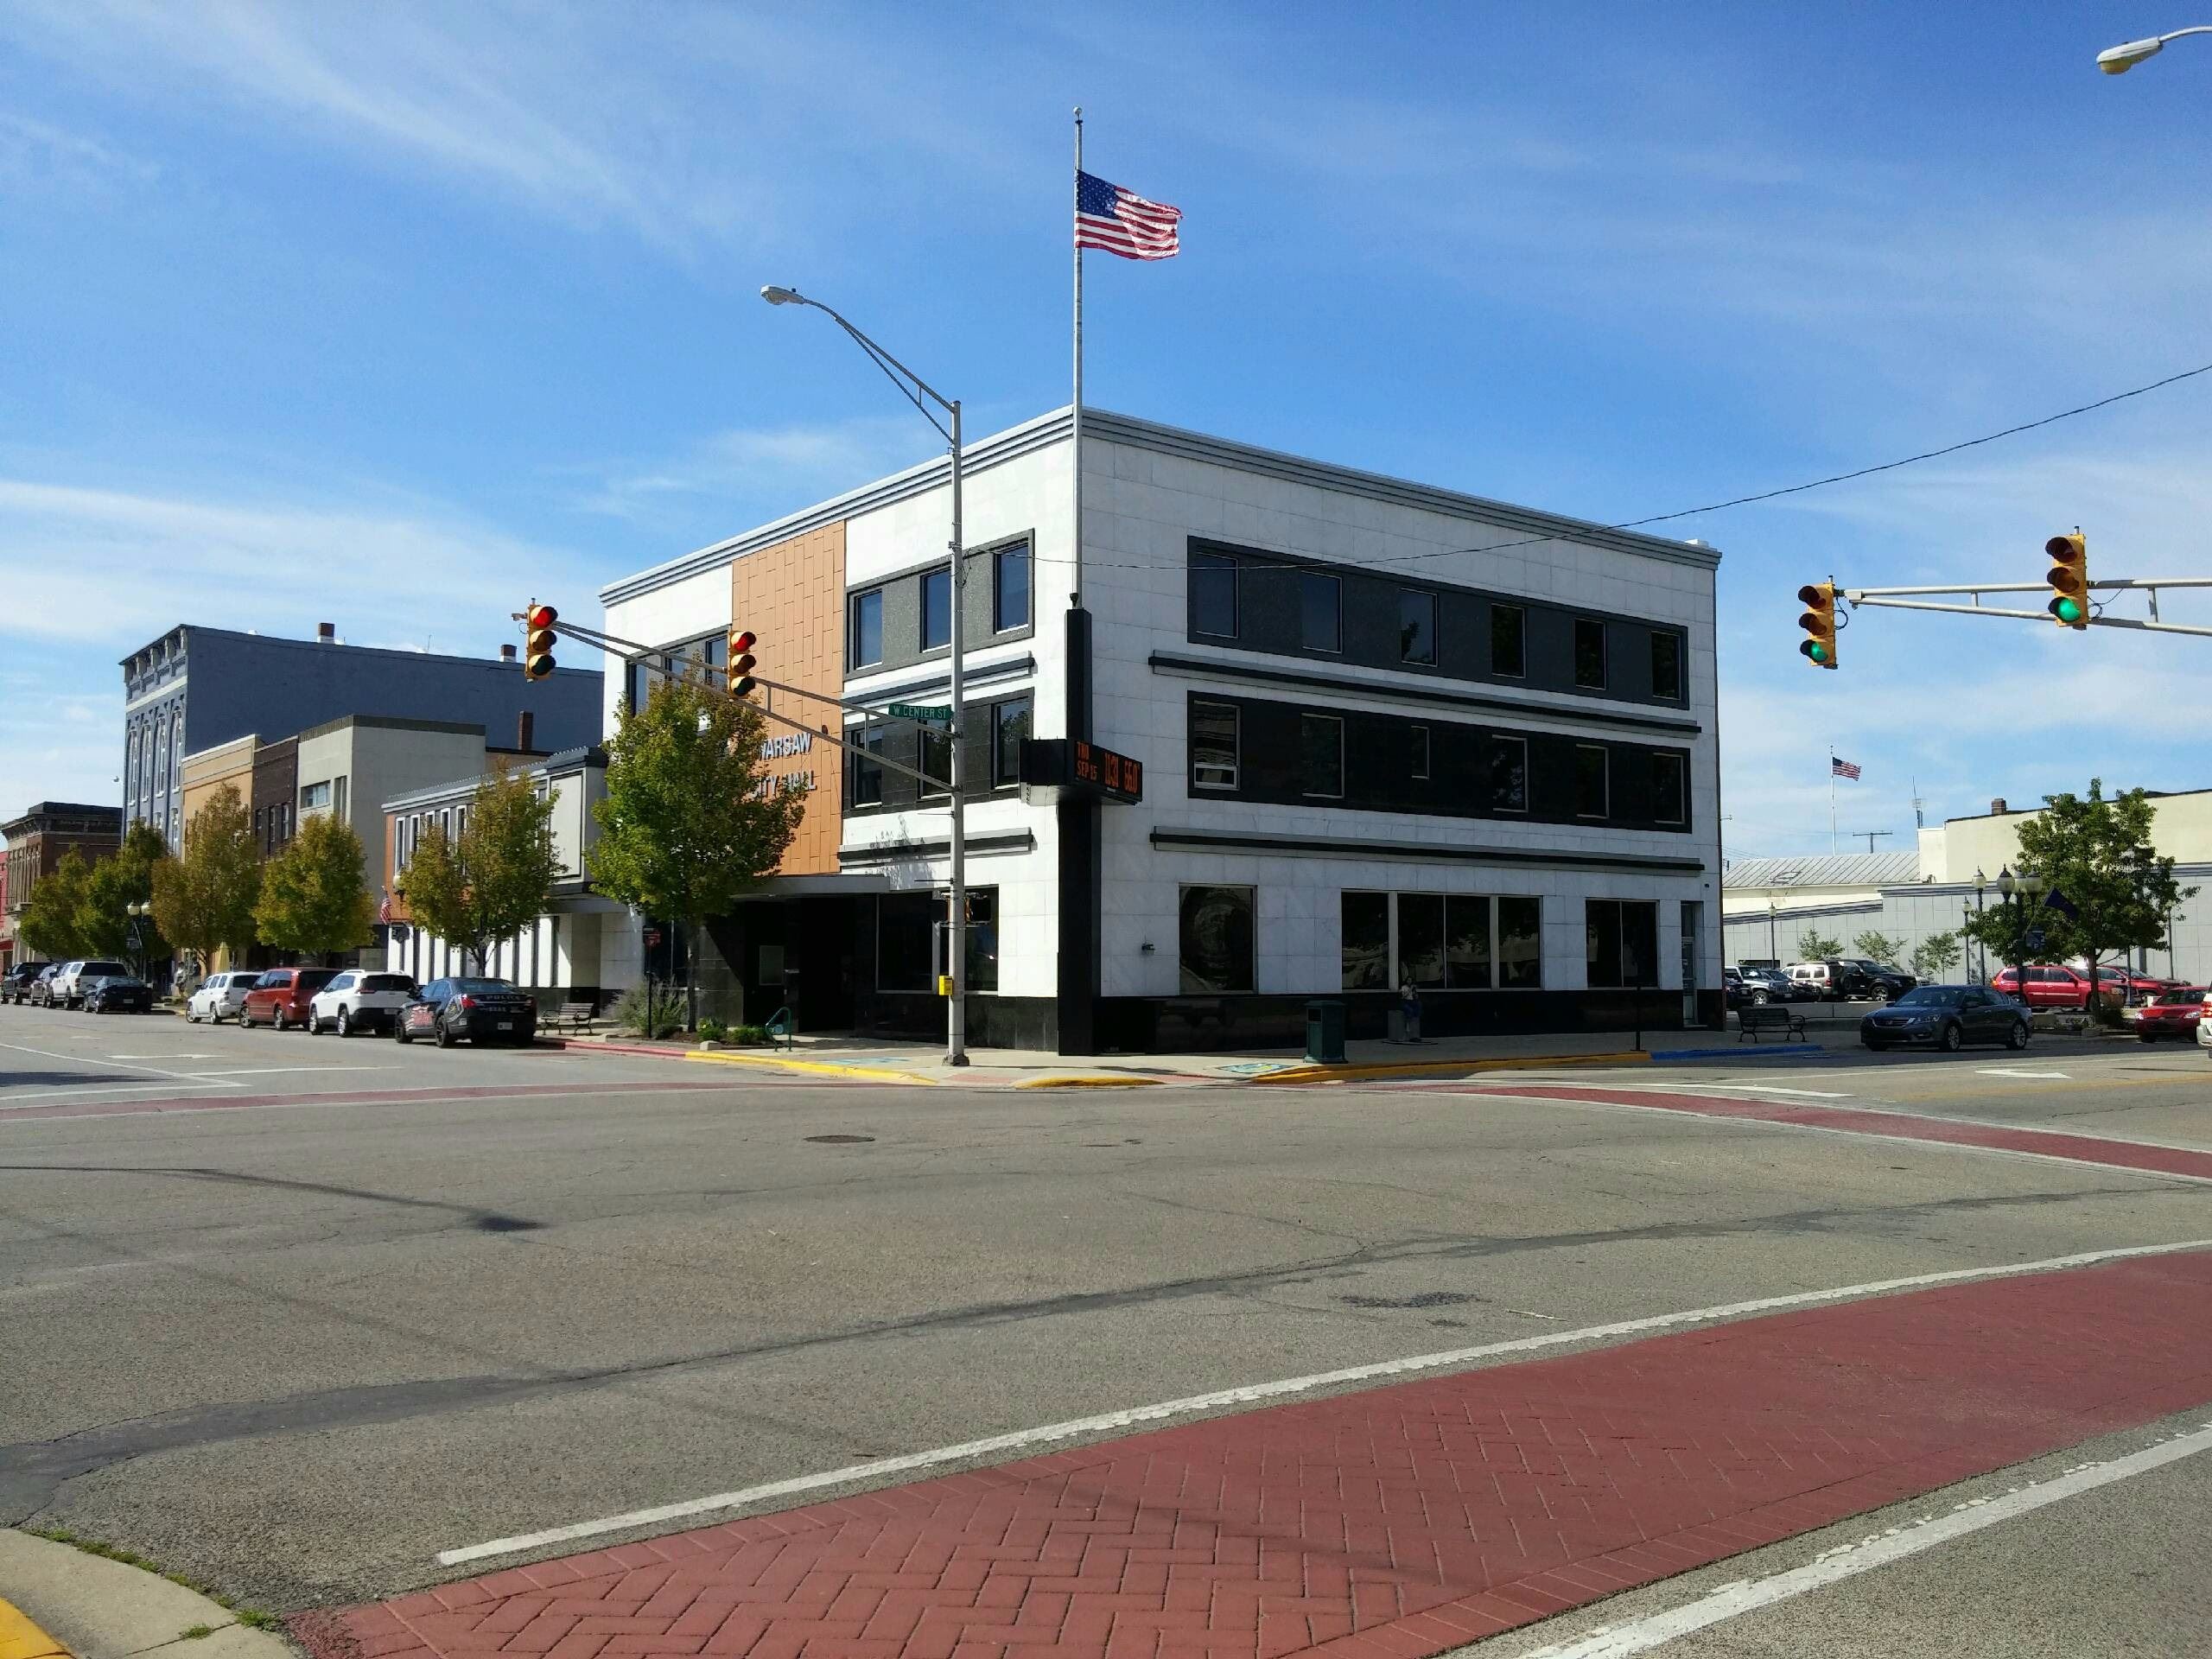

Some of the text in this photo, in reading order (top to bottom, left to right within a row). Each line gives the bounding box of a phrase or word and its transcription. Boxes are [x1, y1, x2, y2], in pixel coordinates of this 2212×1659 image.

[893, 705, 948, 719] W CENTER ST
[1077, 760, 1090, 779] SEP
